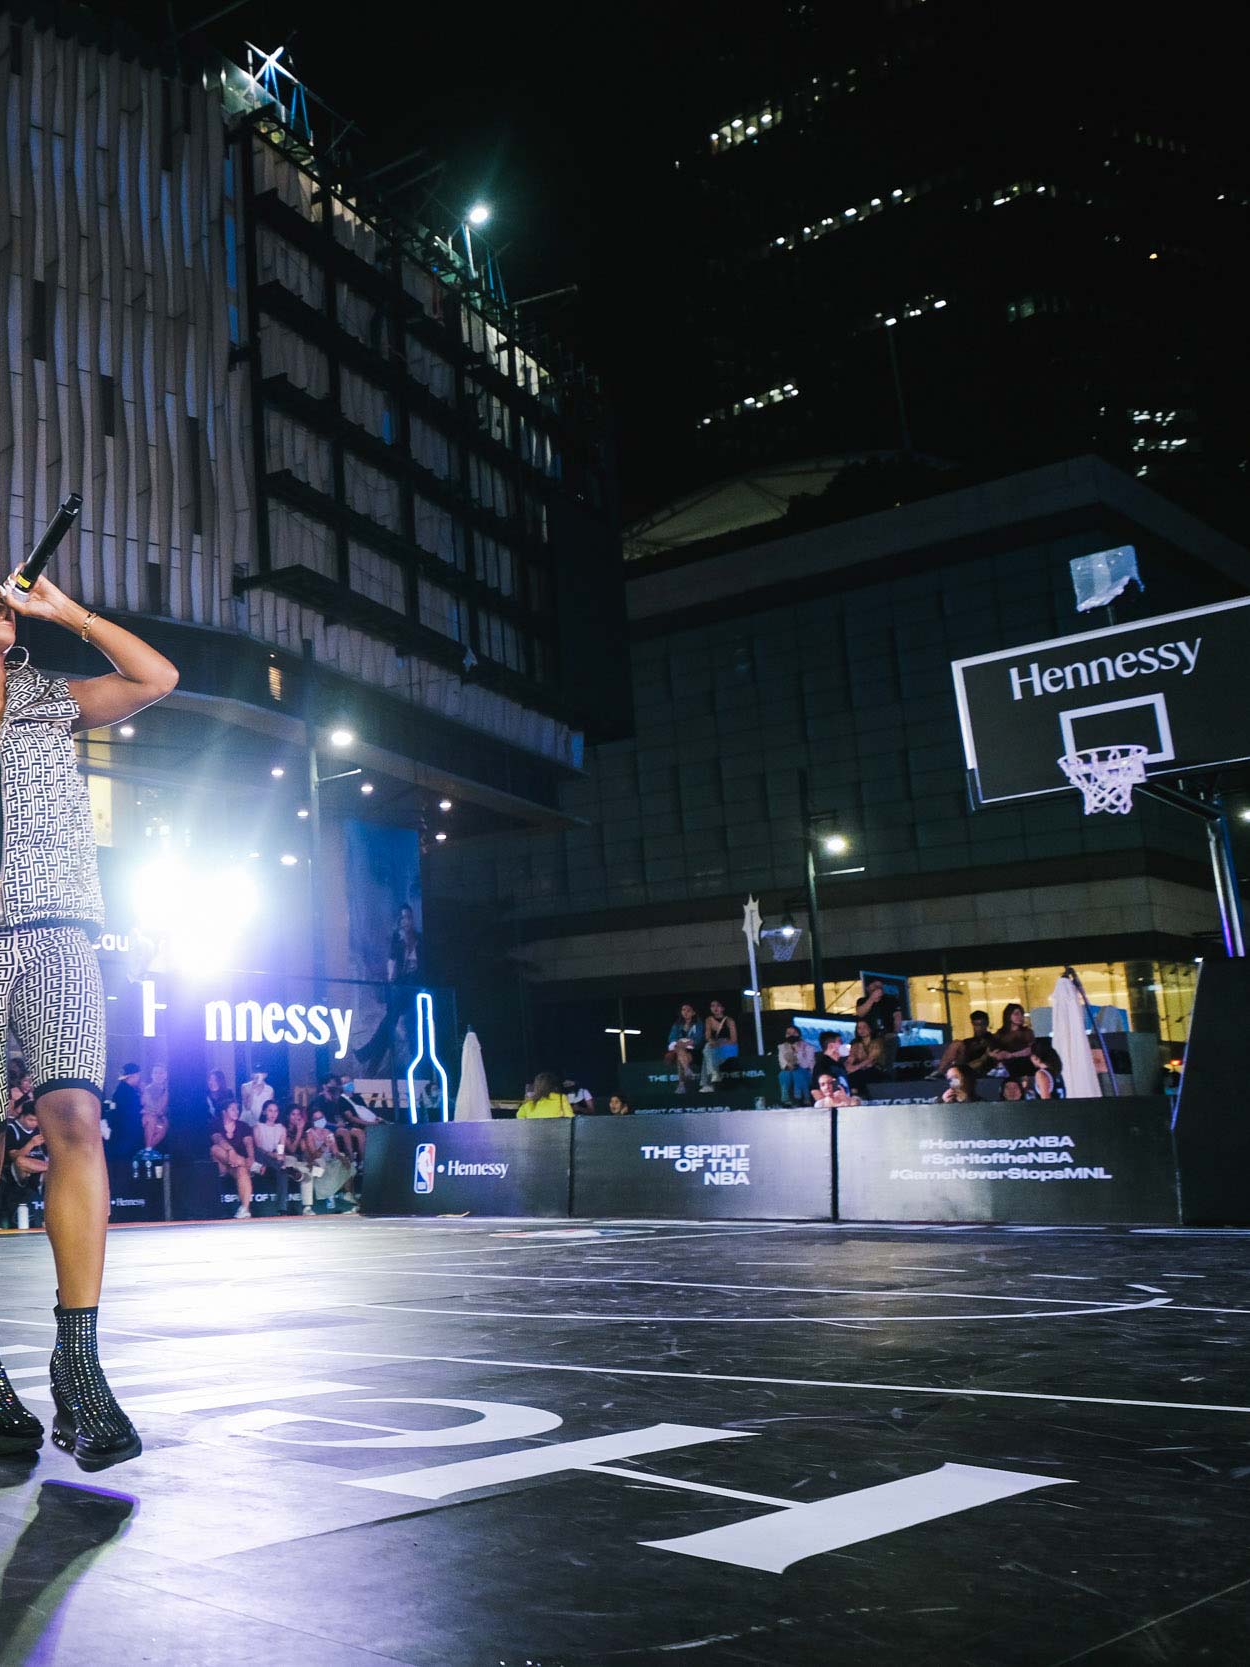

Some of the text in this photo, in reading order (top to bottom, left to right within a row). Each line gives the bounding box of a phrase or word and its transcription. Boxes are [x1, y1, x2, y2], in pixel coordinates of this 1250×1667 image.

[1009, 638, 1201, 701] Hennessy
[142, 980, 352, 1059] Hnnessy
[918, 1136, 1075, 1150] #HennessyxNBA
[641, 1144, 750, 1159] THE SPIRIT
[921, 1151, 1073, 1165] #SpiritoftheNBA
[447, 1160, 509, 1179] Hennessy
[675, 1158, 750, 1172] OF THE
[704, 1171, 750, 1185] NBA
[889, 1167, 1113, 1181] #GameNeverStopsMNL
